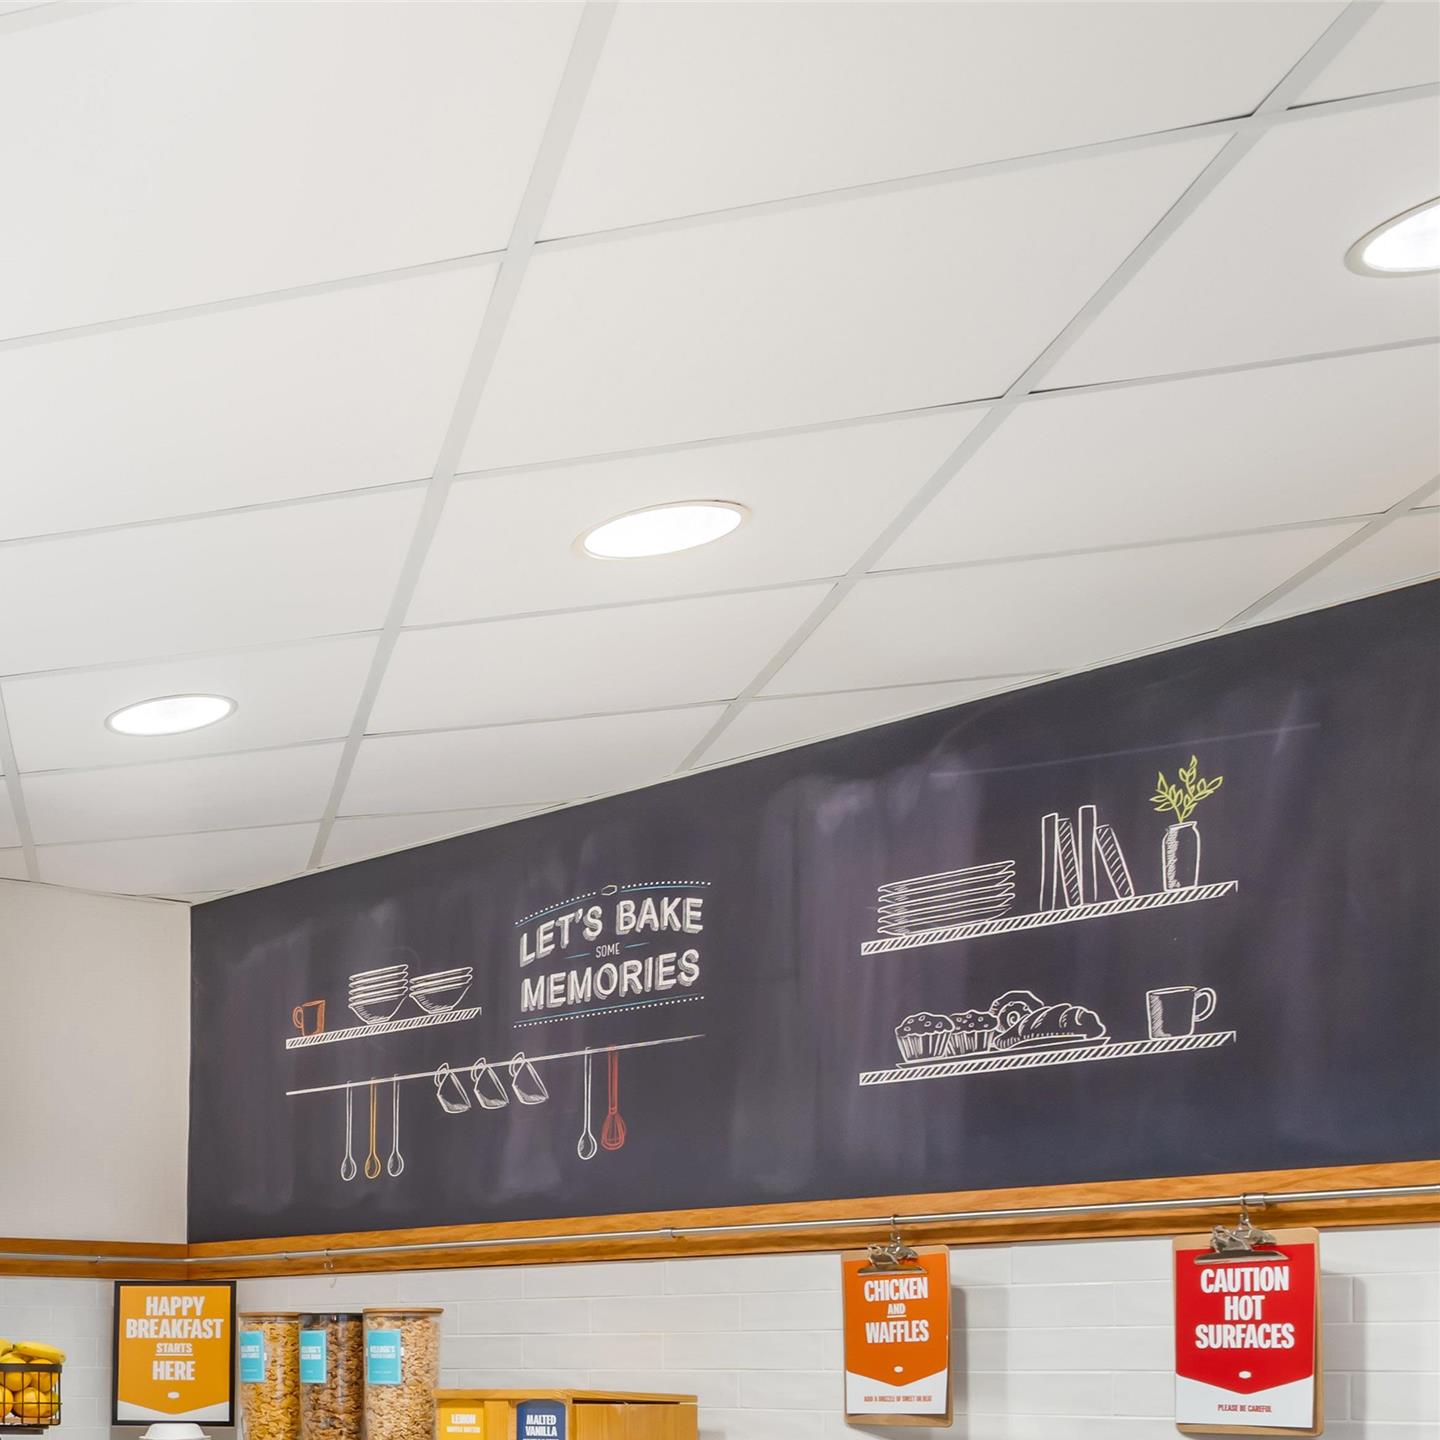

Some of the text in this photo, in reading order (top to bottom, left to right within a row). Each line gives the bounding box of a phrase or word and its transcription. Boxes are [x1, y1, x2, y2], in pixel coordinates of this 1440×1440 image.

[520, 897, 704, 967] LET'S BAKE
[595, 942, 620, 958] SOME
[520, 948, 701, 1013] MEMORIES
[864, 1277, 928, 1302] CHICKEN
[1200, 1266, 1290, 1294] CAUTION
[145, 1296, 205, 1316] HAPPY
[887, 1303, 906, 1315] AND
[1224, 1295, 1265, 1321] HOT
[125, 1318, 224, 1339] BREAKFAST
[865, 1320, 930, 1344] WAFFLES
[1195, 1323, 1295, 1349] SURFACES
[156, 1343, 193, 1353] STARTS
[152, 1360, 196, 1381] HERE
[1218, 1404, 1238, 1412] PLEASE
[1247, 1405, 1272, 1413] CAREFUL
[526, 1414, 556, 1426] MALTED
[525, 1426, 558, 1437] VANILLA
